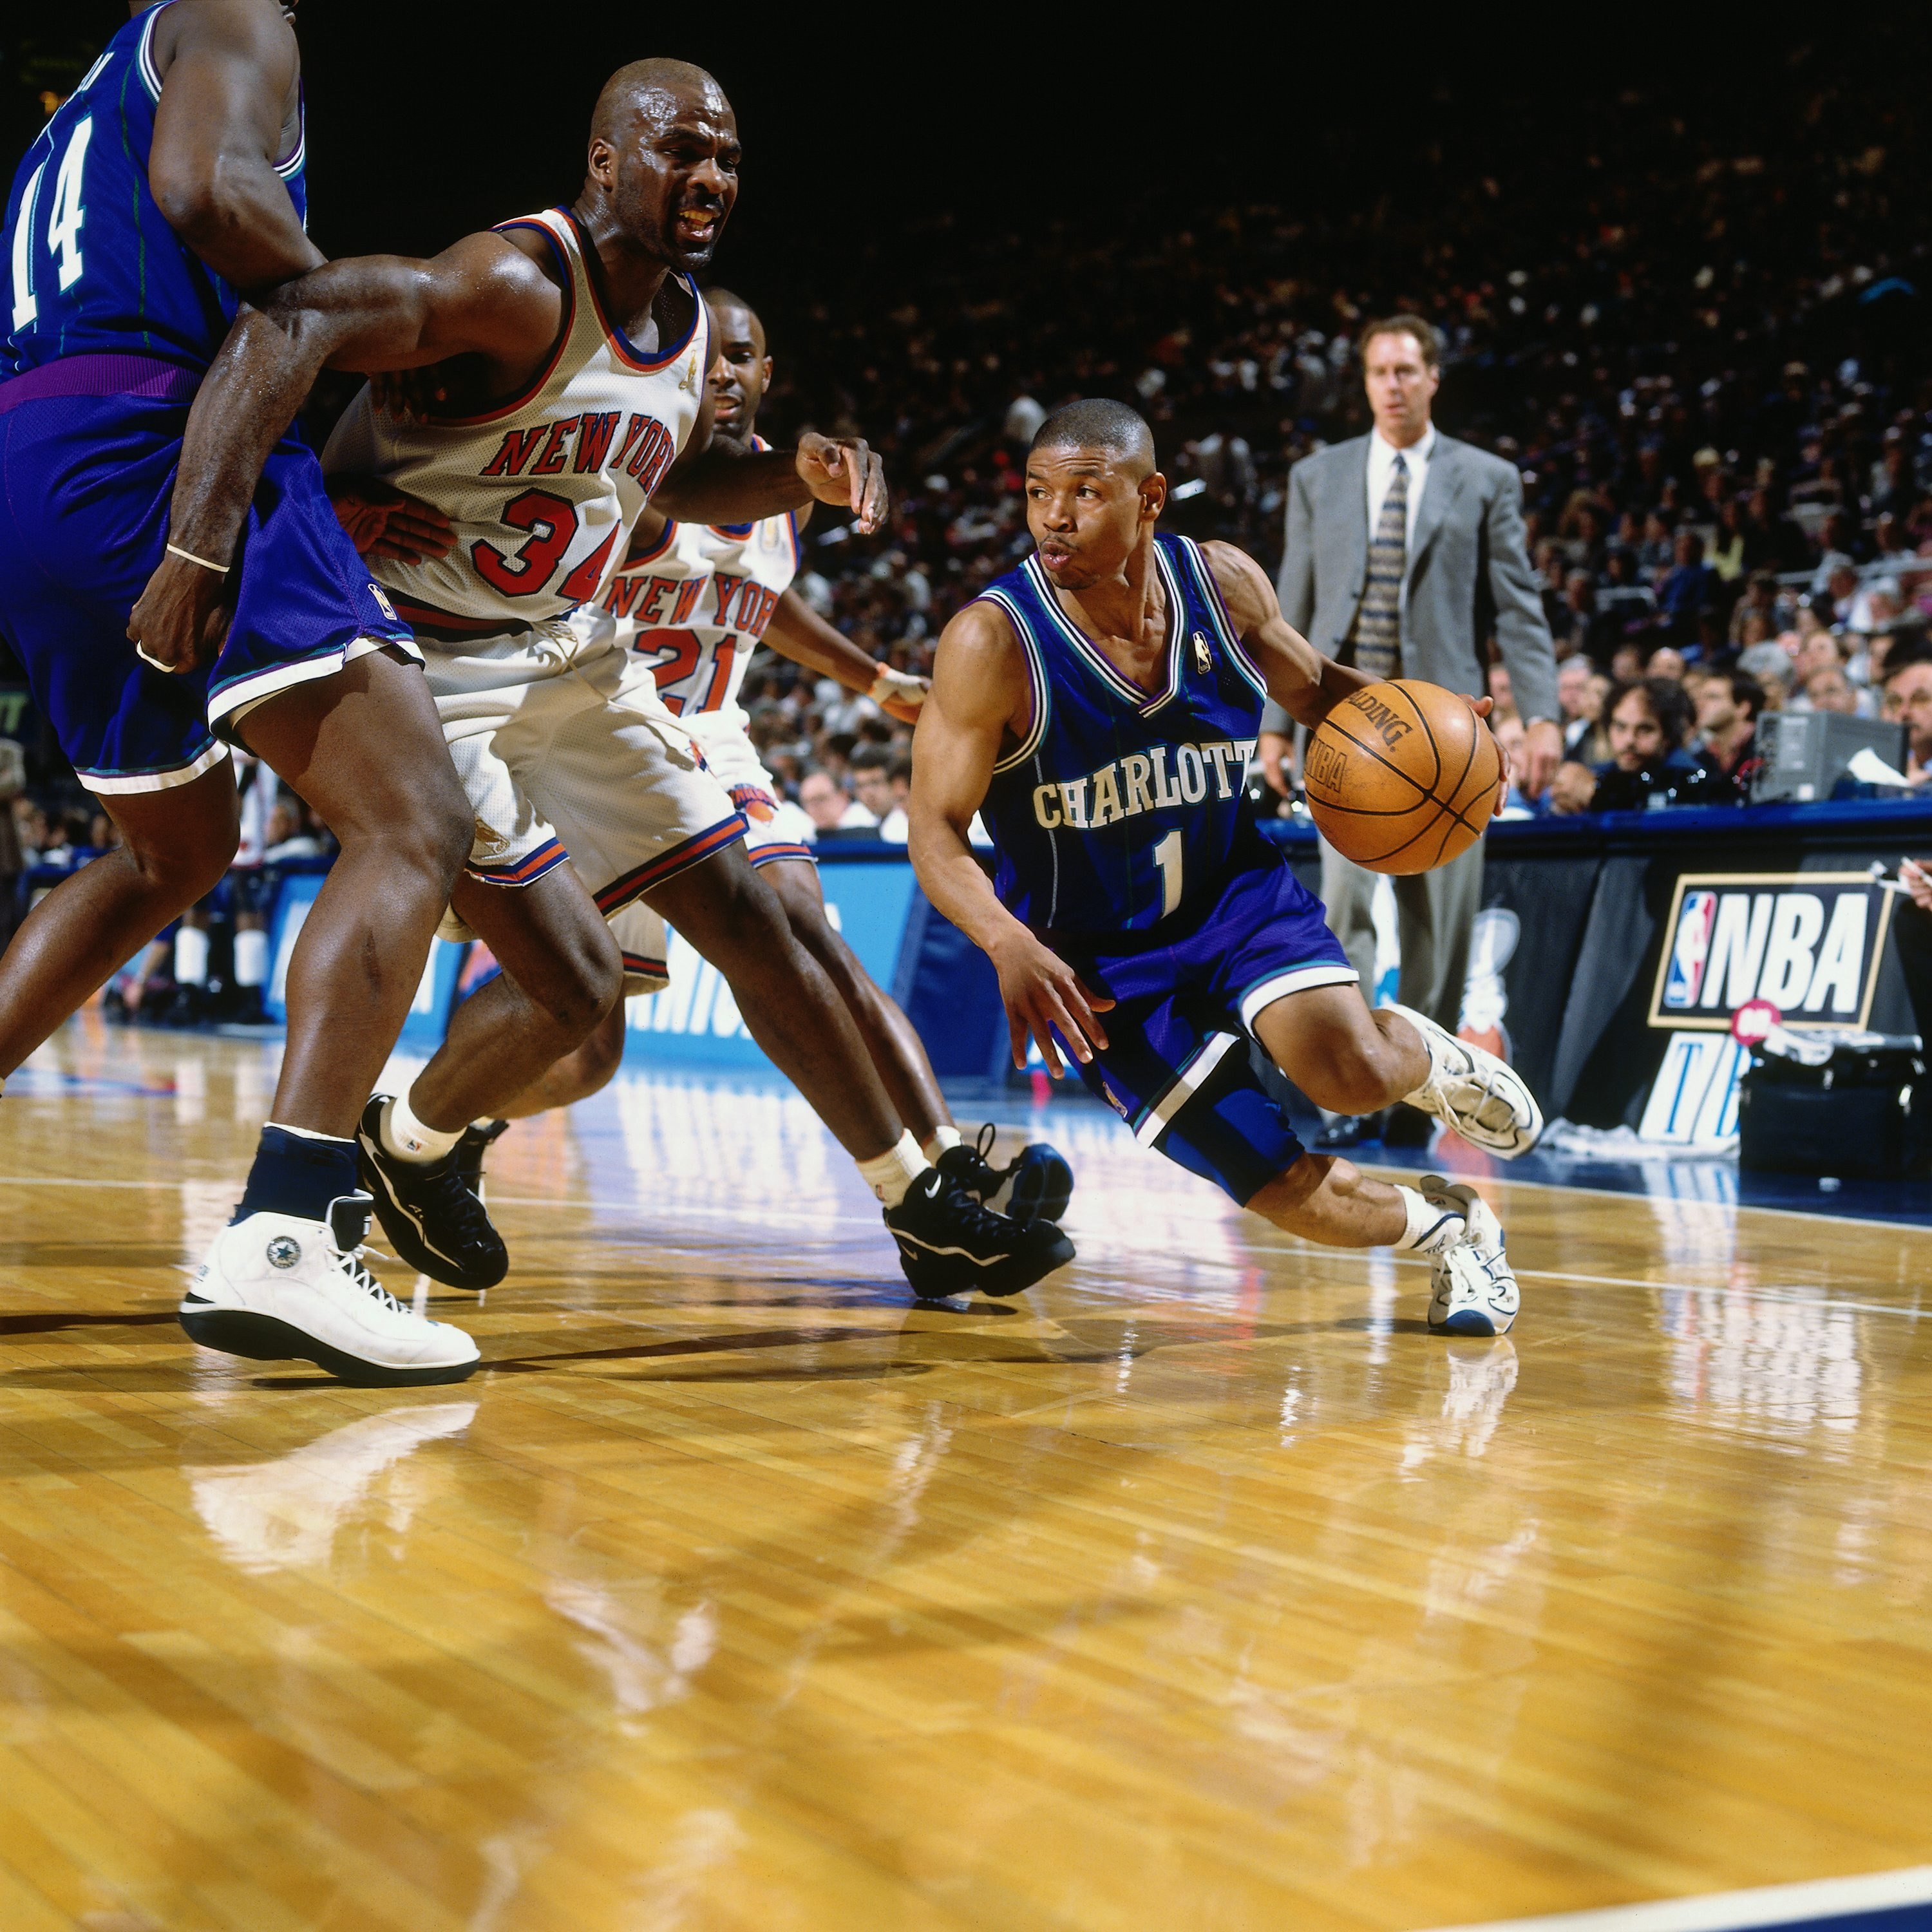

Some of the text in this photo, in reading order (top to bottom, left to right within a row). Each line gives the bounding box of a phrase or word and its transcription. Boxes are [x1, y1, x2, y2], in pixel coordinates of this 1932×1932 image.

[12, 114, 93, 334] 14
[480, 410, 622, 477] NEW
[469, 487, 621, 608] 34
[603, 575, 708, 625] NEW
[632, 627, 737, 719] 21
[1345, 690, 1413, 747] ALDING
[1152, 828, 1184, 920] 1
[1700, 893, 1869, 1014] NBA
